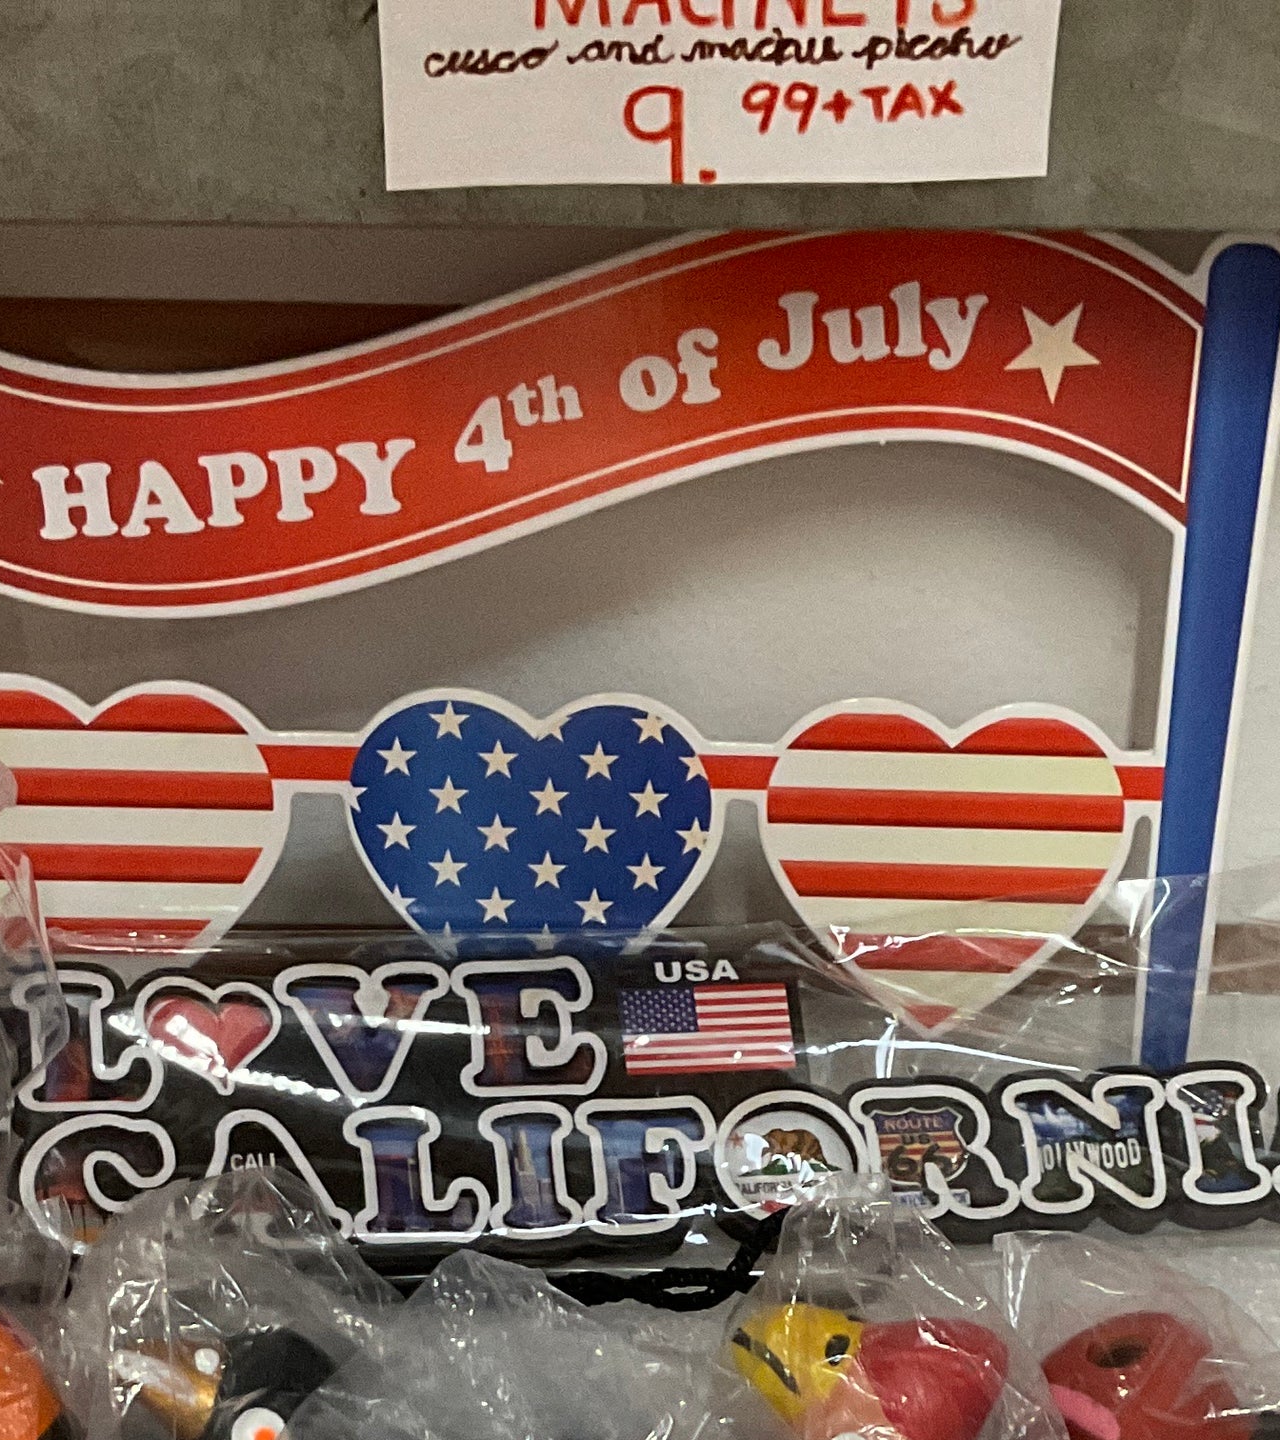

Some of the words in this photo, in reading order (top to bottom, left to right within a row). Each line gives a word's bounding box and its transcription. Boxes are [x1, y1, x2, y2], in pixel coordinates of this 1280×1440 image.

[566, 33, 675, 66] and
[31, 436, 417, 541] HAPPY
[453, 374, 584, 474] 4th
[618, 326, 722, 413] of
[755, 280, 990, 372] July
[653, 958, 740, 984] USA
[883, 1113, 944, 1132] ROUTE
